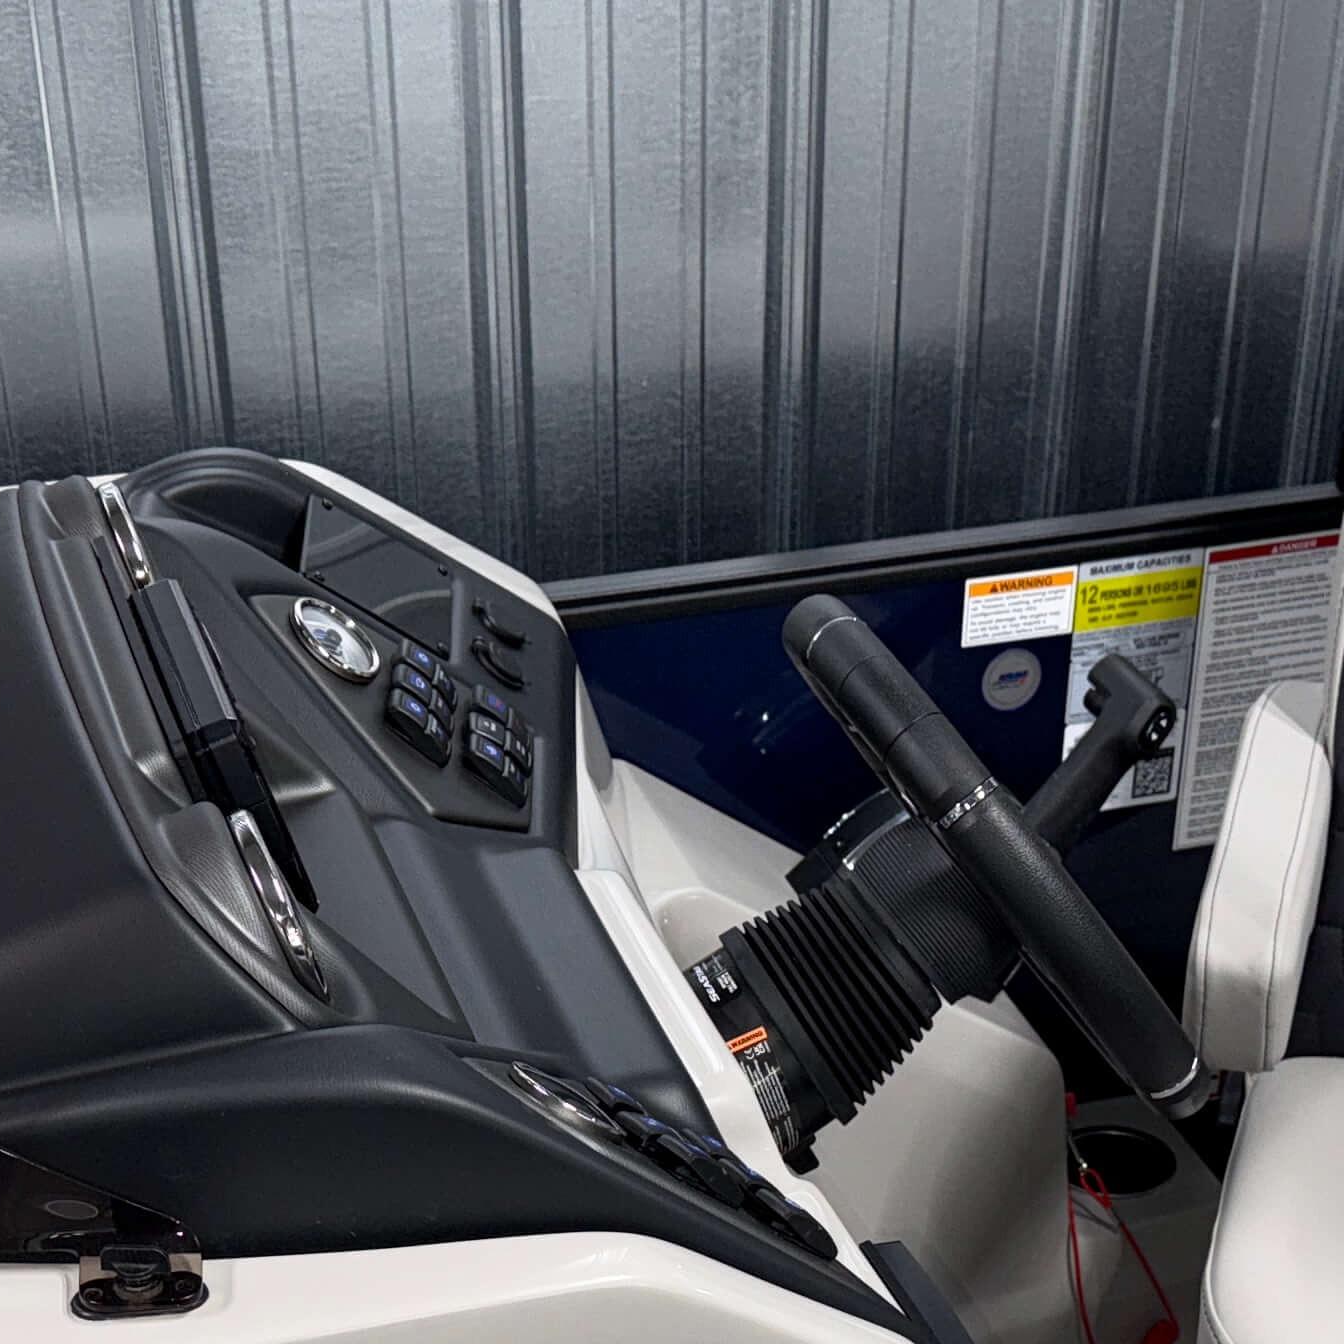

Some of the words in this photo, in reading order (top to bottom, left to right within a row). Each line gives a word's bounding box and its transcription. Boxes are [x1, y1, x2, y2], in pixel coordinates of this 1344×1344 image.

[1090, 562, 1135, 576] MAXIMUM
[1136, 553, 1192, 570] CAPACITIES
[999, 575, 1054, 592] WARNING
[1080, 585, 1099, 606] 12
